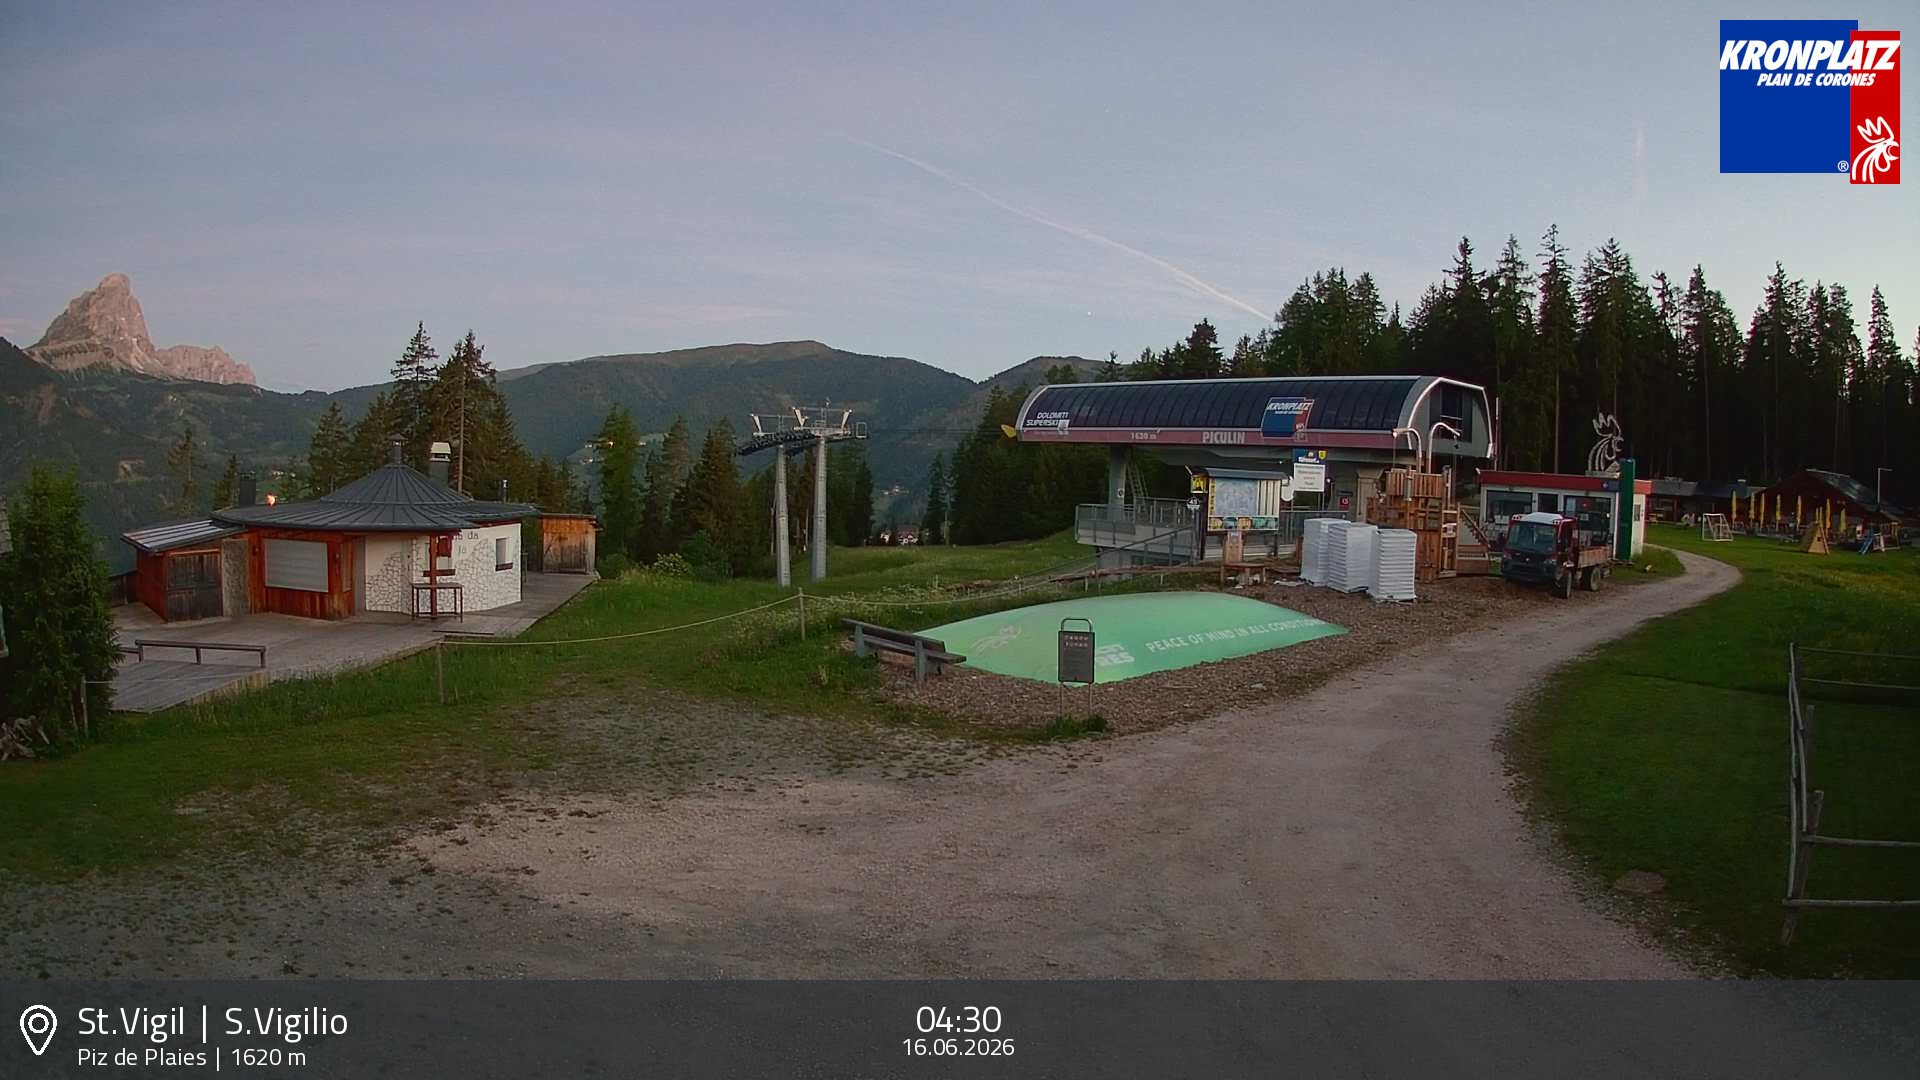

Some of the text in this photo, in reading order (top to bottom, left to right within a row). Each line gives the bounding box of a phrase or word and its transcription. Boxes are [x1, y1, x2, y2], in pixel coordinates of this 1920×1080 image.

[1026, 419, 1059, 427] SUPERSKI
[1202, 431, 1246, 444] PICULIN
[1145, 636, 1189, 653] PEACE
[1187, 632, 1204, 645] OF
[1204, 628, 1237, 641] MIND
